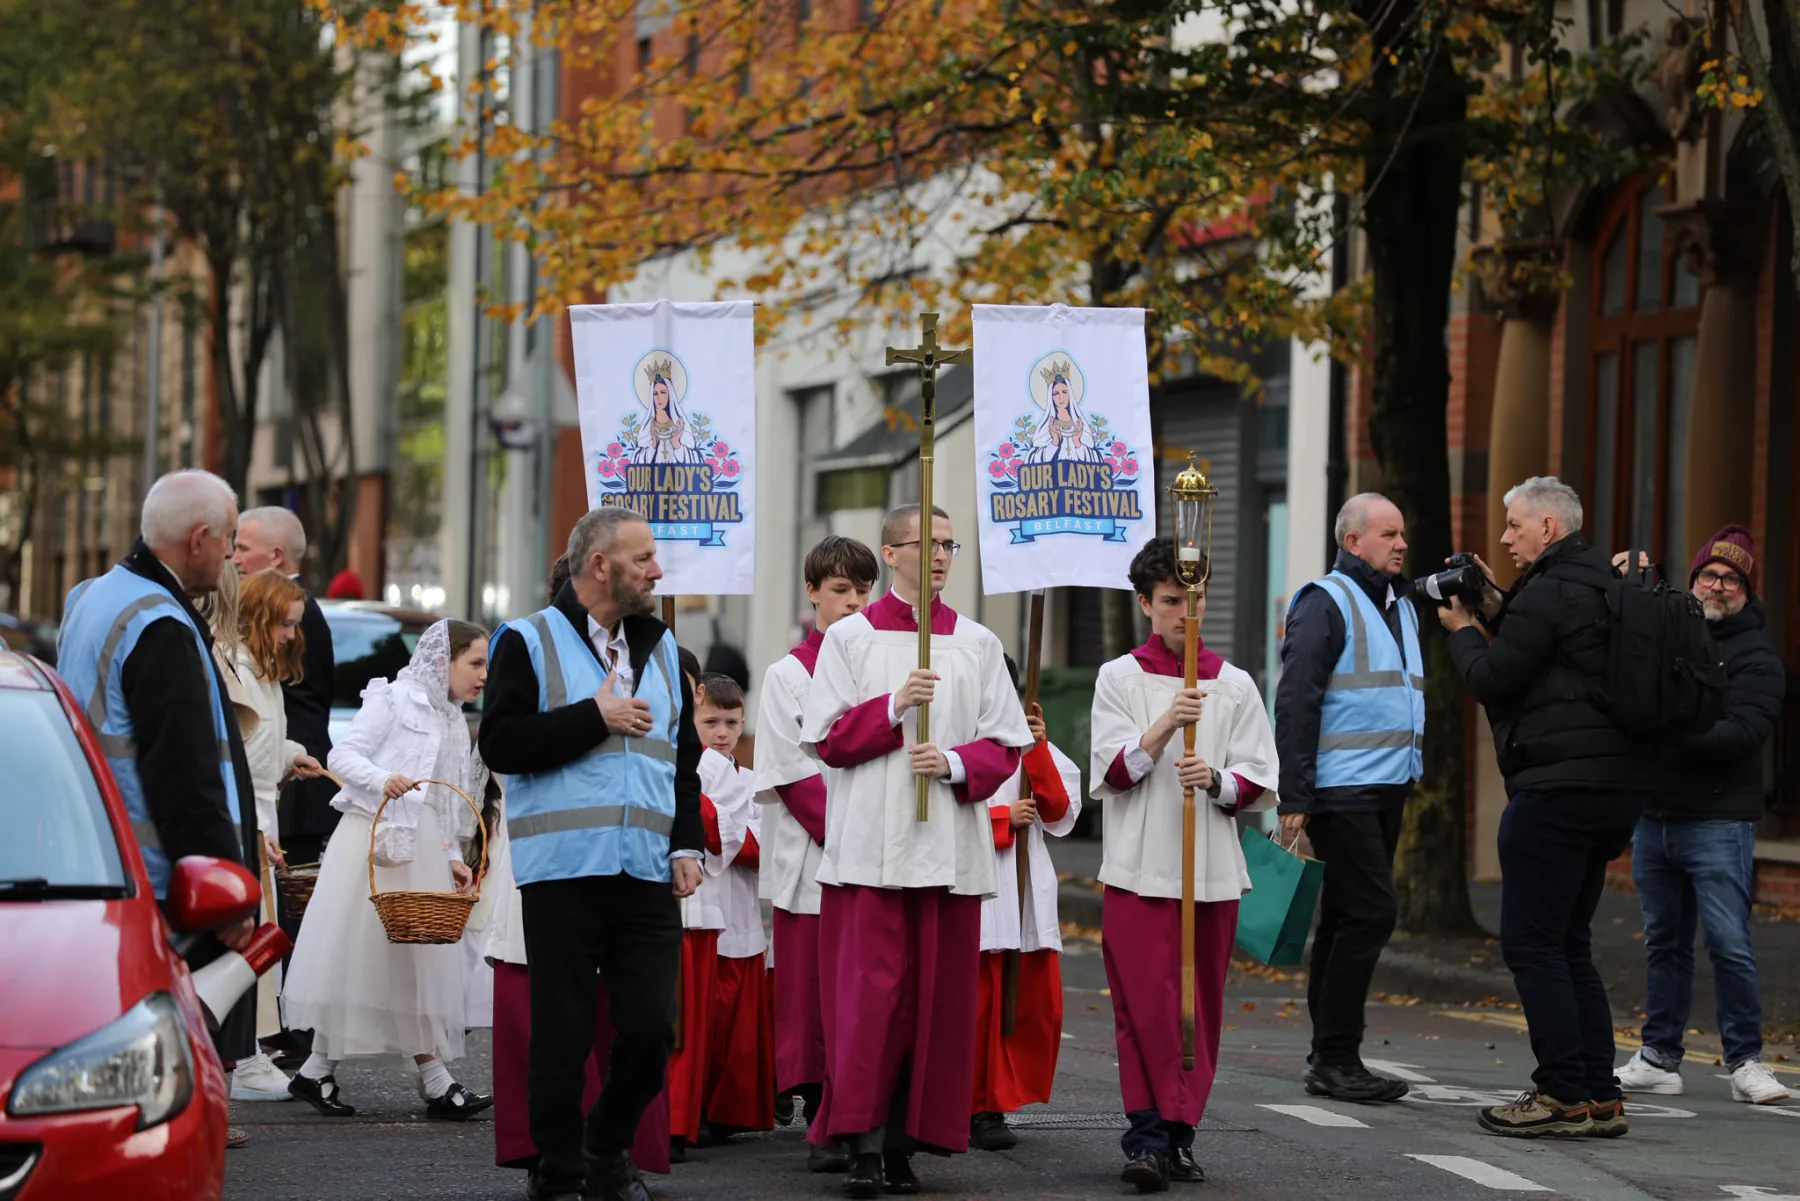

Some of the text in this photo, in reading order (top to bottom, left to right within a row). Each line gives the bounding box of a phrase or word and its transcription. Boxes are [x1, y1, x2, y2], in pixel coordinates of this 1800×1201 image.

[628, 466, 711, 492] OUR LADY'S
[1020, 462, 1112, 491] OUR LADY'S
[659, 494, 741, 520] FESTIVAL
[993, 489, 1141, 520] ROSARY FESTIVAL
[654, 525, 699, 536] FAST
[1034, 519, 1103, 531] BELFAST
